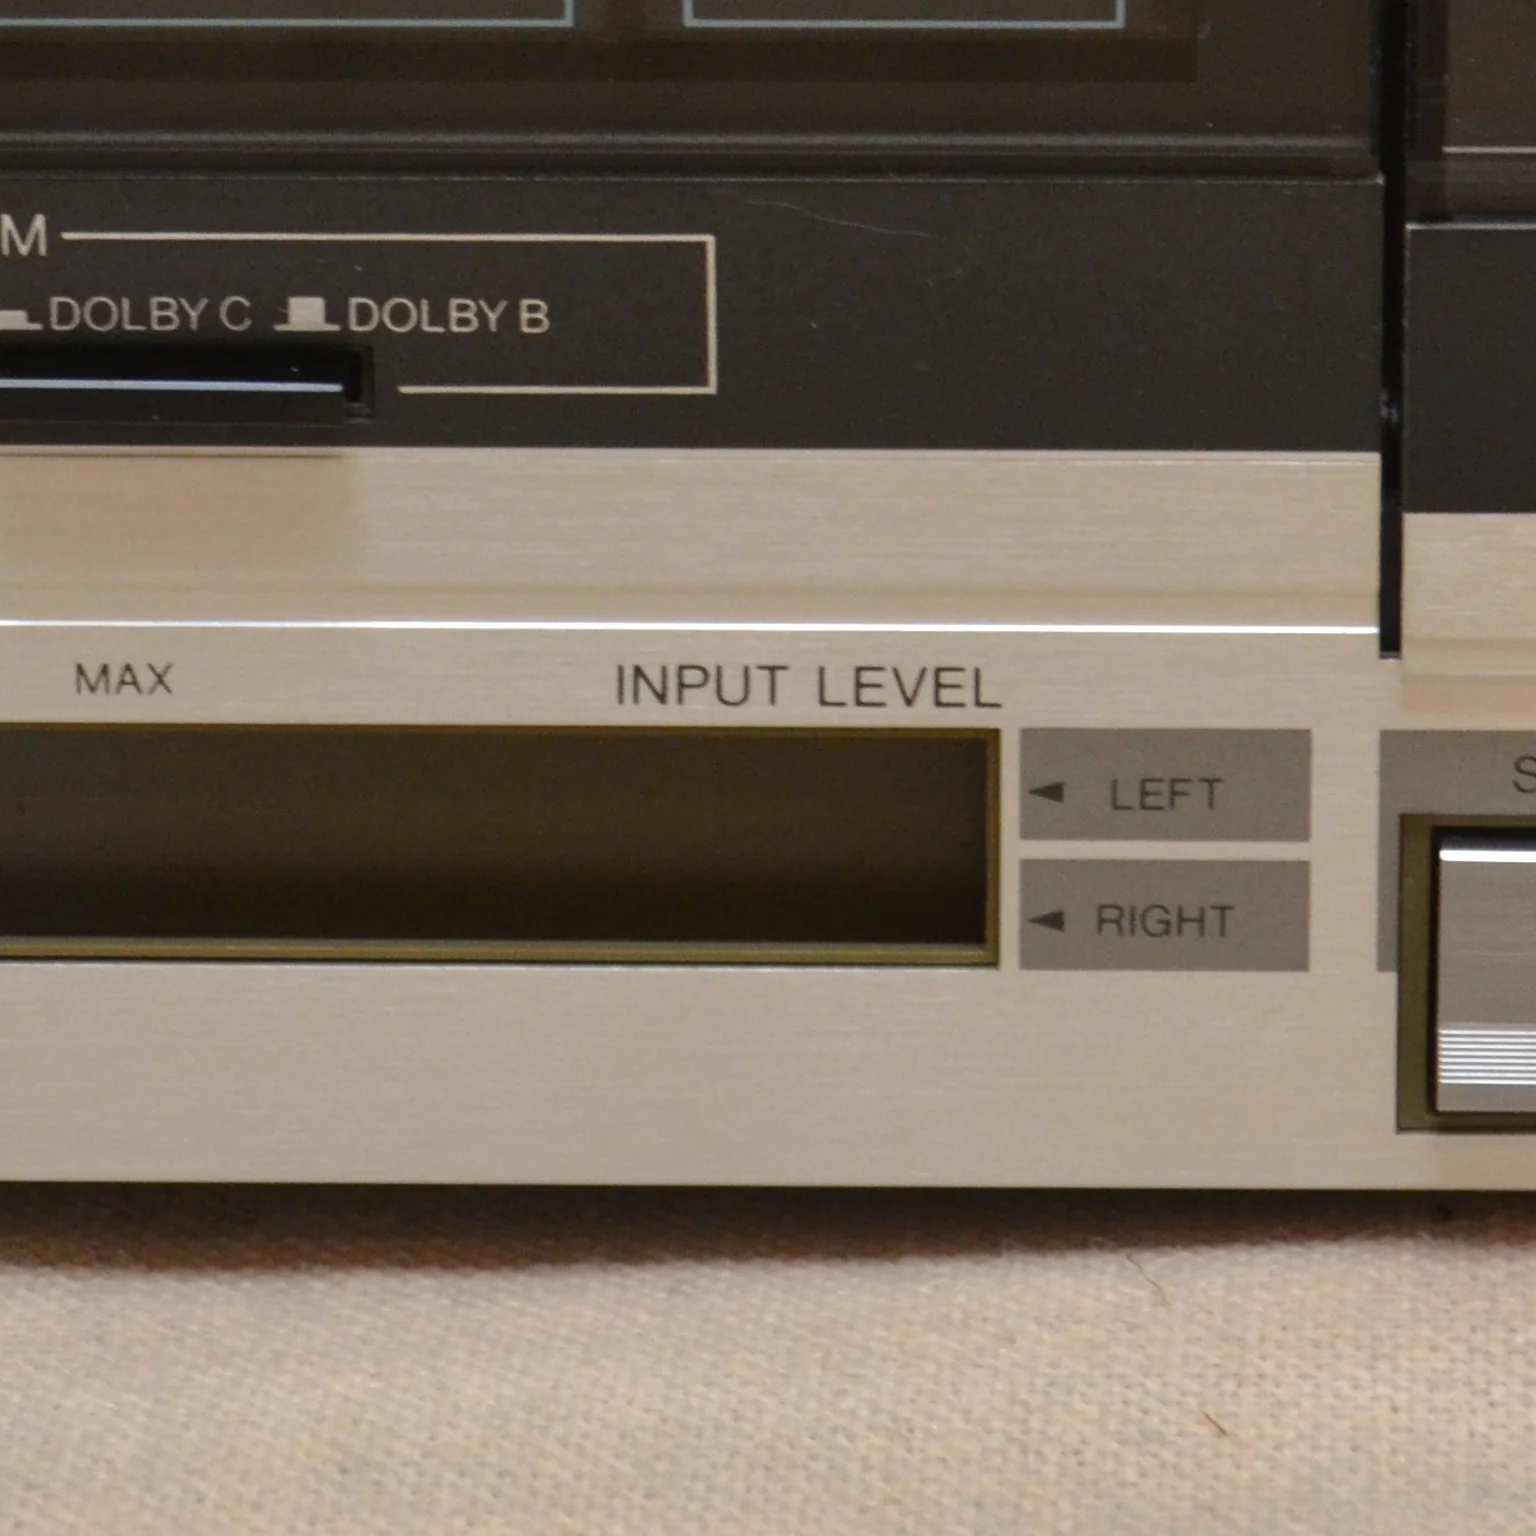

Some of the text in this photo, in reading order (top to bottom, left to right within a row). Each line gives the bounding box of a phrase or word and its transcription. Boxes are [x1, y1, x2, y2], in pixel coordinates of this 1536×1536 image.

[49, 295, 251, 331] DOLBY C
[349, 297, 549, 333] DOLBY B
[76, 663, 171, 694] MAX
[617, 664, 1002, 708] INPUT LEVEL
[1111, 777, 1223, 811] LEFT
[1097, 904, 1234, 938] RIGHT
